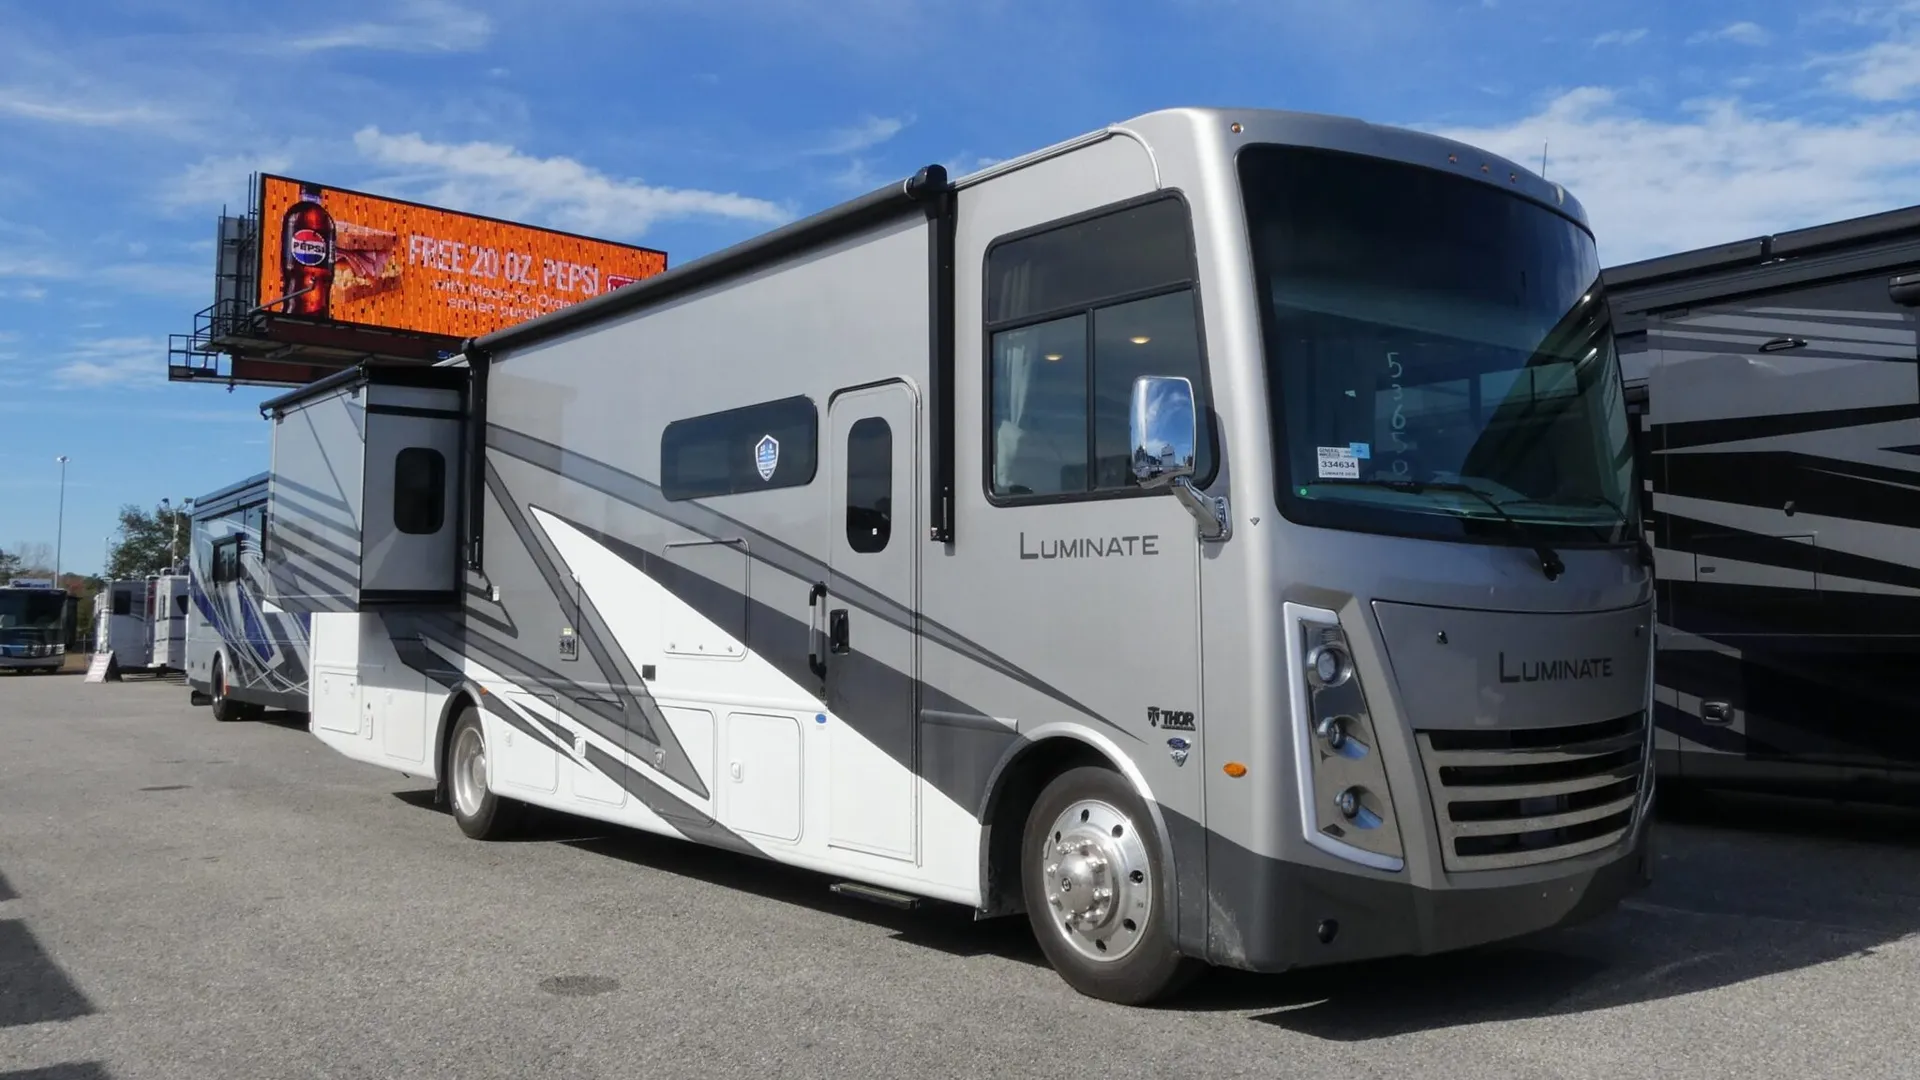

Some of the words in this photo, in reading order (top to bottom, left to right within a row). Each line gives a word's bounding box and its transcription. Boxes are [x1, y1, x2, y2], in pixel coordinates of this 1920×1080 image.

[293, 241, 325, 254] PEPSI
[408, 234, 465, 274] FREE
[469, 245, 499, 279] 20
[543, 258, 599, 297] PEPSI
[433, 280, 466, 294] with
[469, 282, 577, 310] Made-To-Orde
[1321, 460, 1356, 469] 334634
[1020, 532, 1159, 560] LUMINATE
[1499, 651, 1613, 684] LUMINATE
[1160, 709, 1195, 727] THOR
